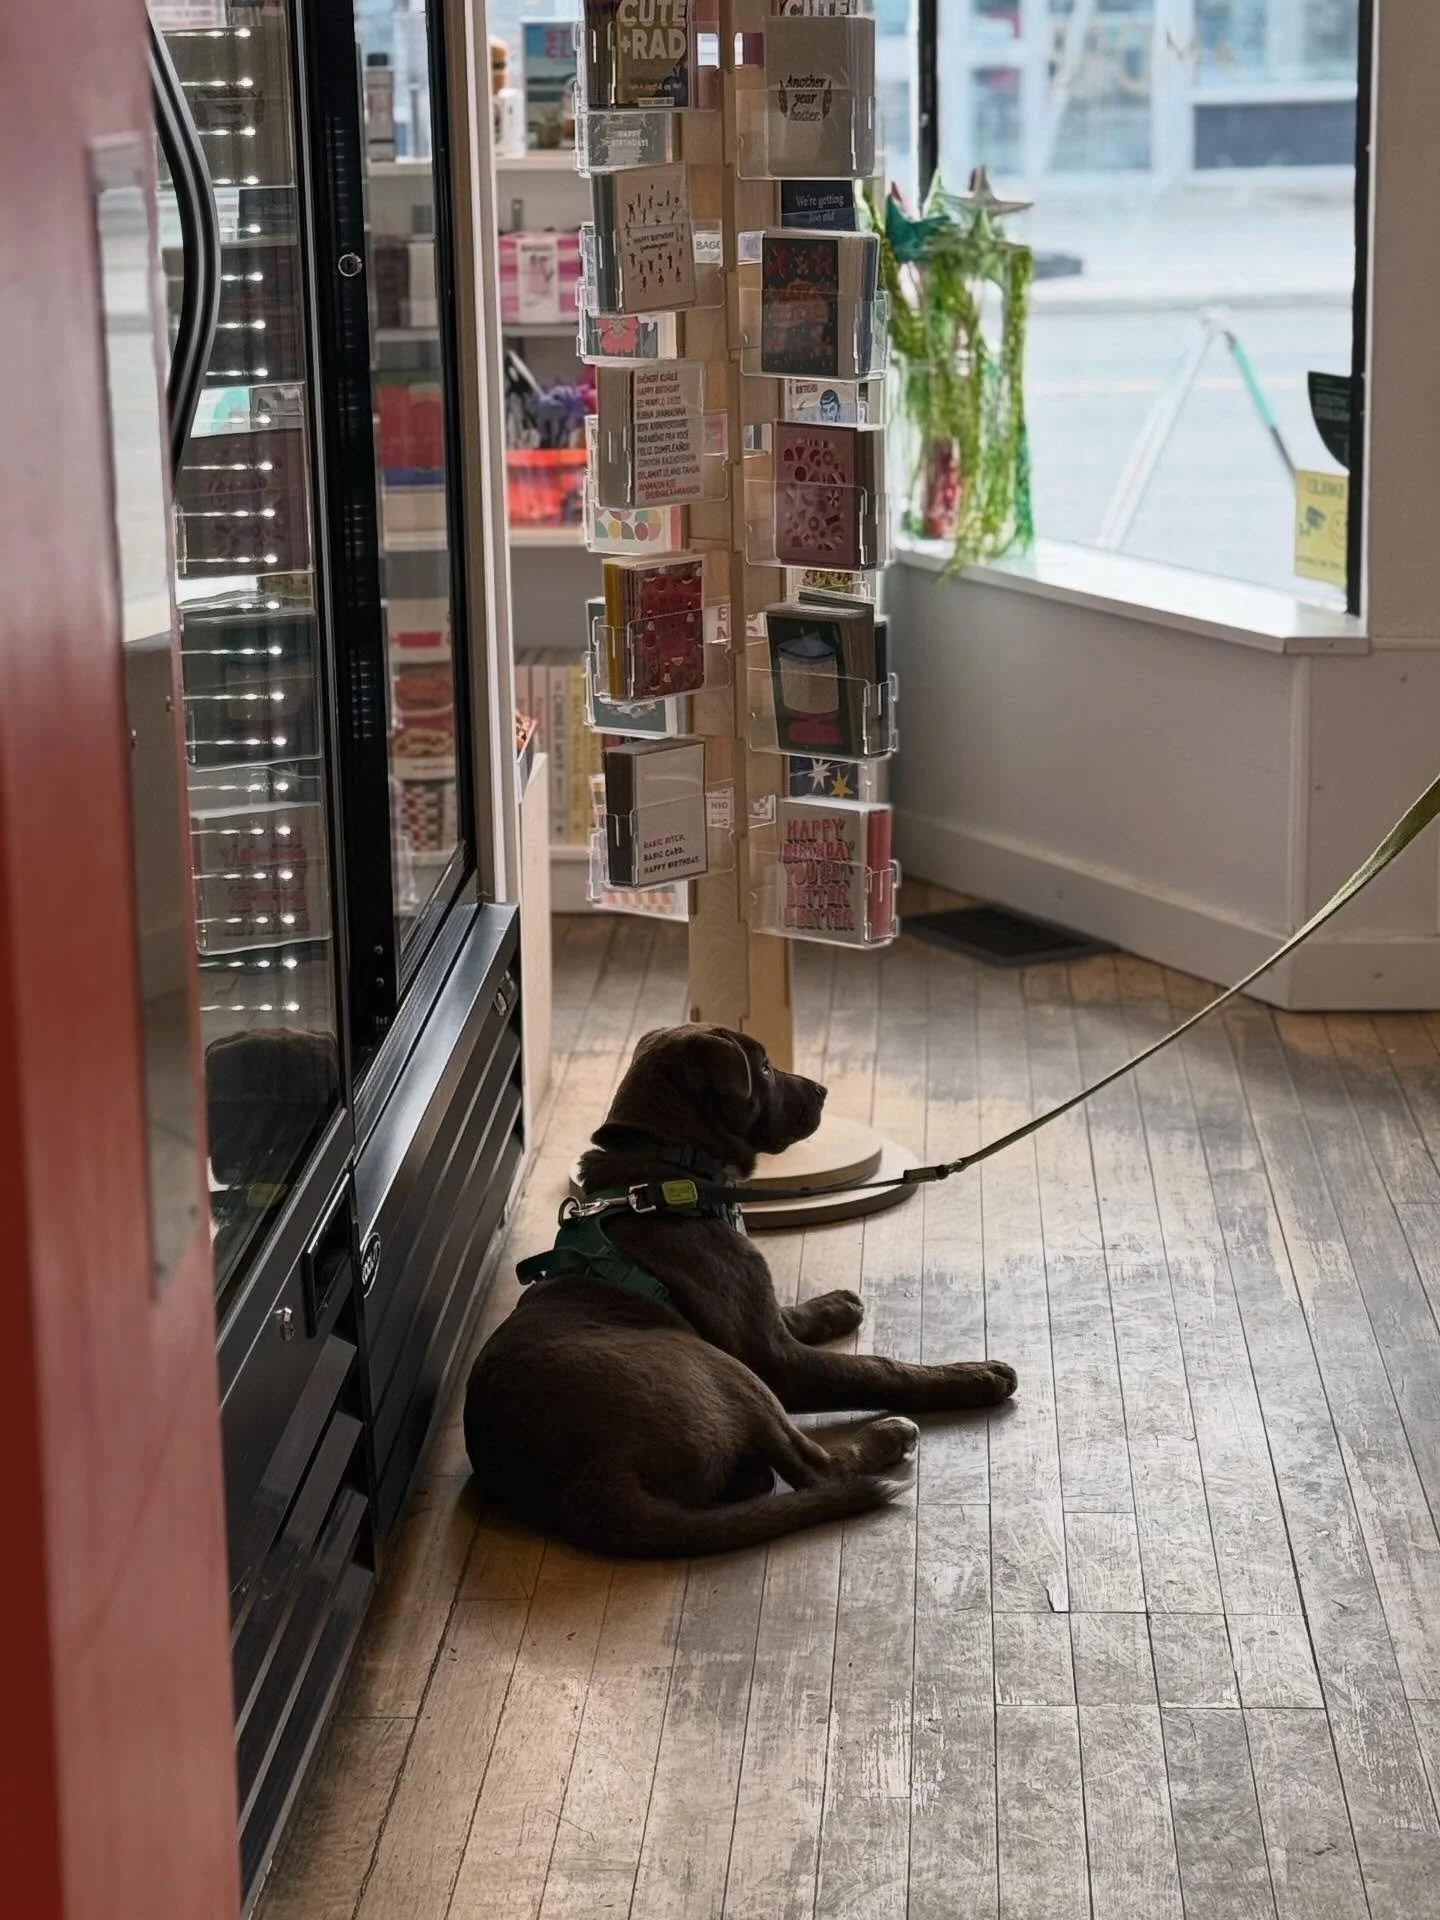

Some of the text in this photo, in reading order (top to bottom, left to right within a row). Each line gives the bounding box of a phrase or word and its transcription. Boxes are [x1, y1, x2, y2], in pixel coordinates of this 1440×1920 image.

[618, 0, 686, 27] CUTE
[785, 74, 827, 88] Another
[791, 92, 818, 109] year
[786, 819, 845, 842] HAPPY
[781, 841, 855, 863] BIRTHDAY
[643, 862, 666, 874] HAPPY
